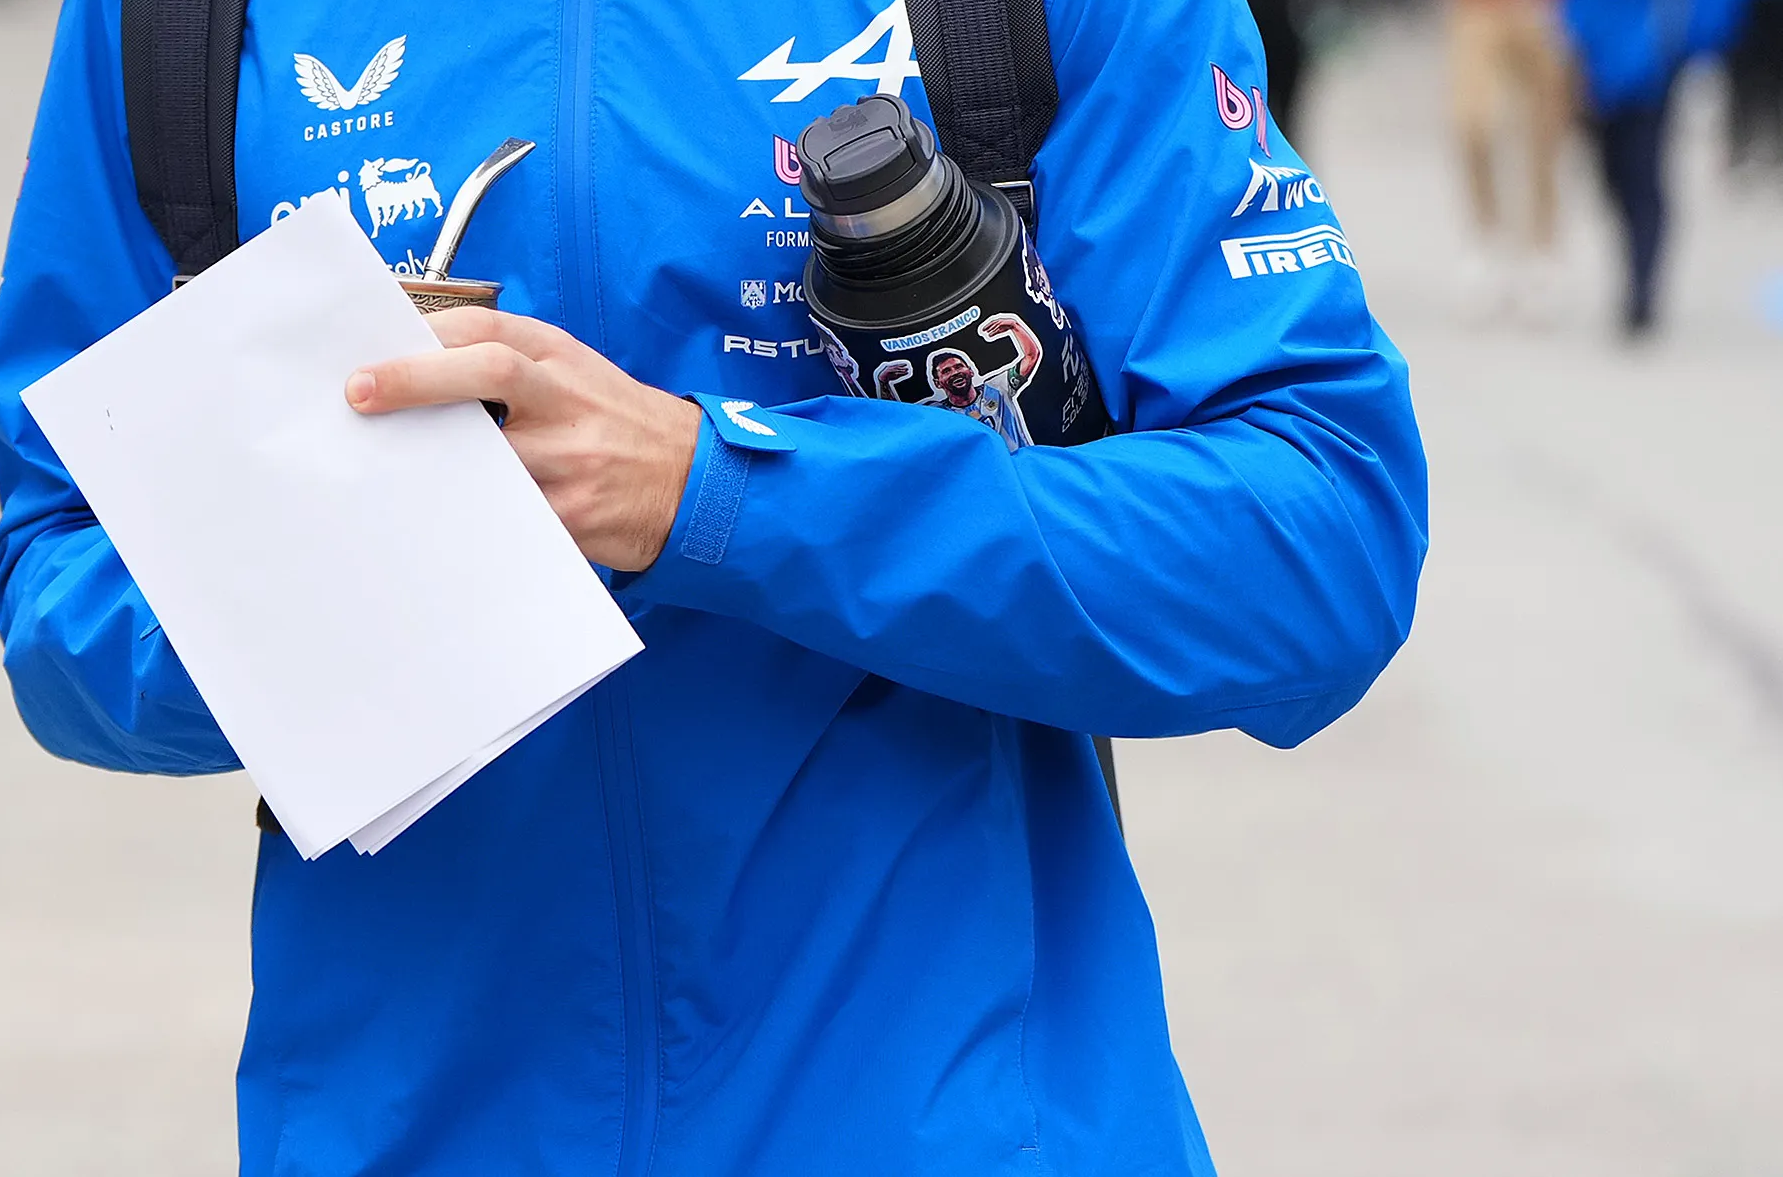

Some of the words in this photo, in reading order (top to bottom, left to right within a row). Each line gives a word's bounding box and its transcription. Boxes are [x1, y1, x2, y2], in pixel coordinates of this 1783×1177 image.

[304, 110, 395, 142] CASTORE
[739, 197, 811, 218] AL
[1284, 177, 1332, 210] WO
[766, 230, 814, 248] FORM
[882, 333, 930, 351] VAMOS
[931, 307, 979, 339] FRANCO
